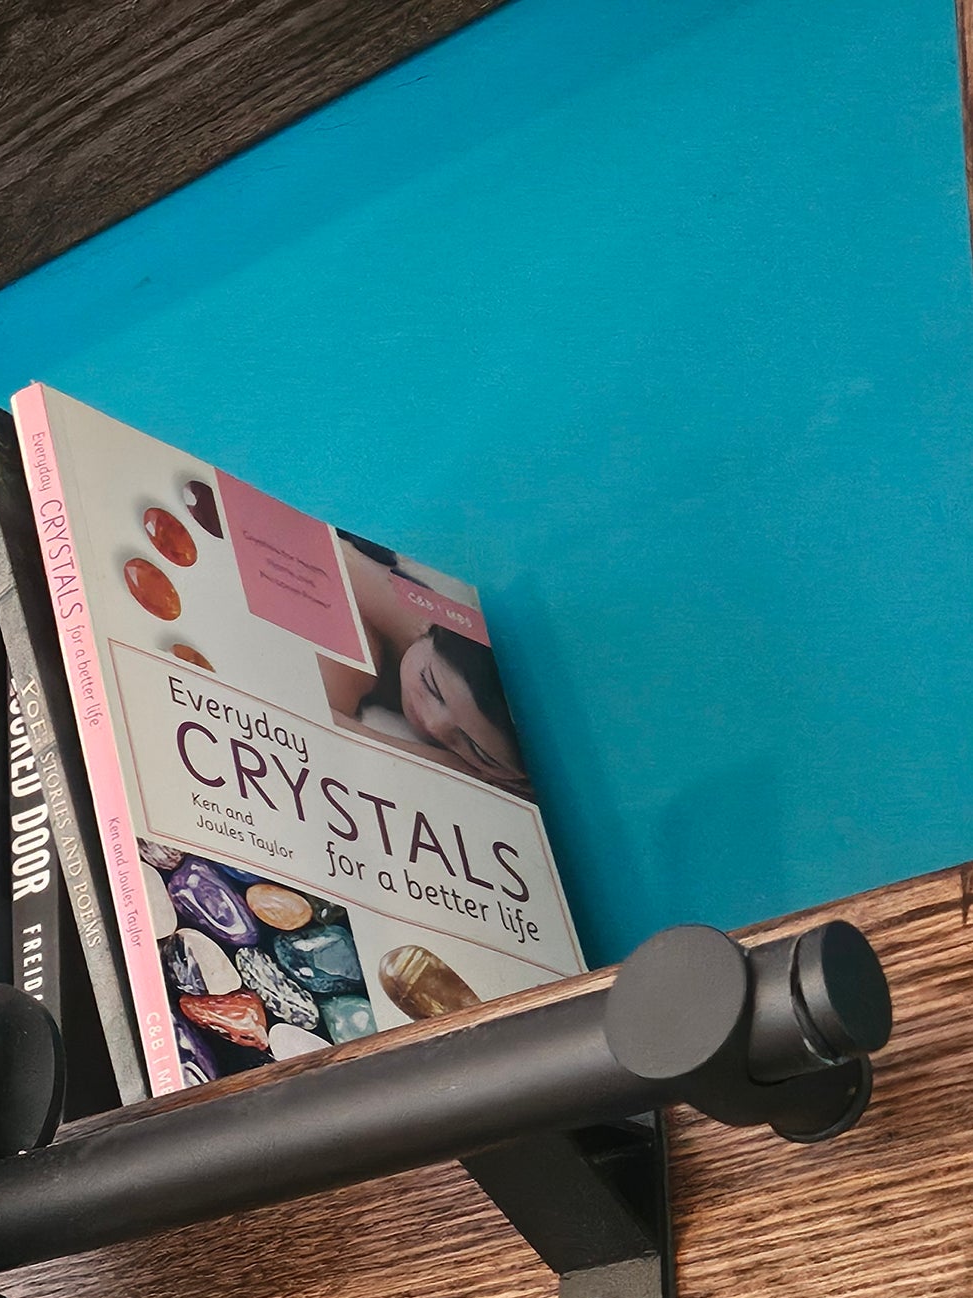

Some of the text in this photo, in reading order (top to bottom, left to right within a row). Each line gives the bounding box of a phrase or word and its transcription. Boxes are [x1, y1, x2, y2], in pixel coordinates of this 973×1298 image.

[32, 431, 103, 728] Everyday CRYSTALS for a better life
[168, 675, 311, 764] Everyday
[11, 808, 52, 903] DOOR
[40, 750, 74, 832] STORIES
[61, 834, 84, 877] AND
[74, 879, 102, 949] POEMS
[176, 721, 531, 903] CRYSTALS
[191, 791, 256, 827] Ken and
[196, 815, 294, 861] Joules Taylor
[109, 815, 143, 949] Ken and Joules Taylor
[326, 840, 541, 944] for a better life
[146, 1011, 165, 1051] C&B
